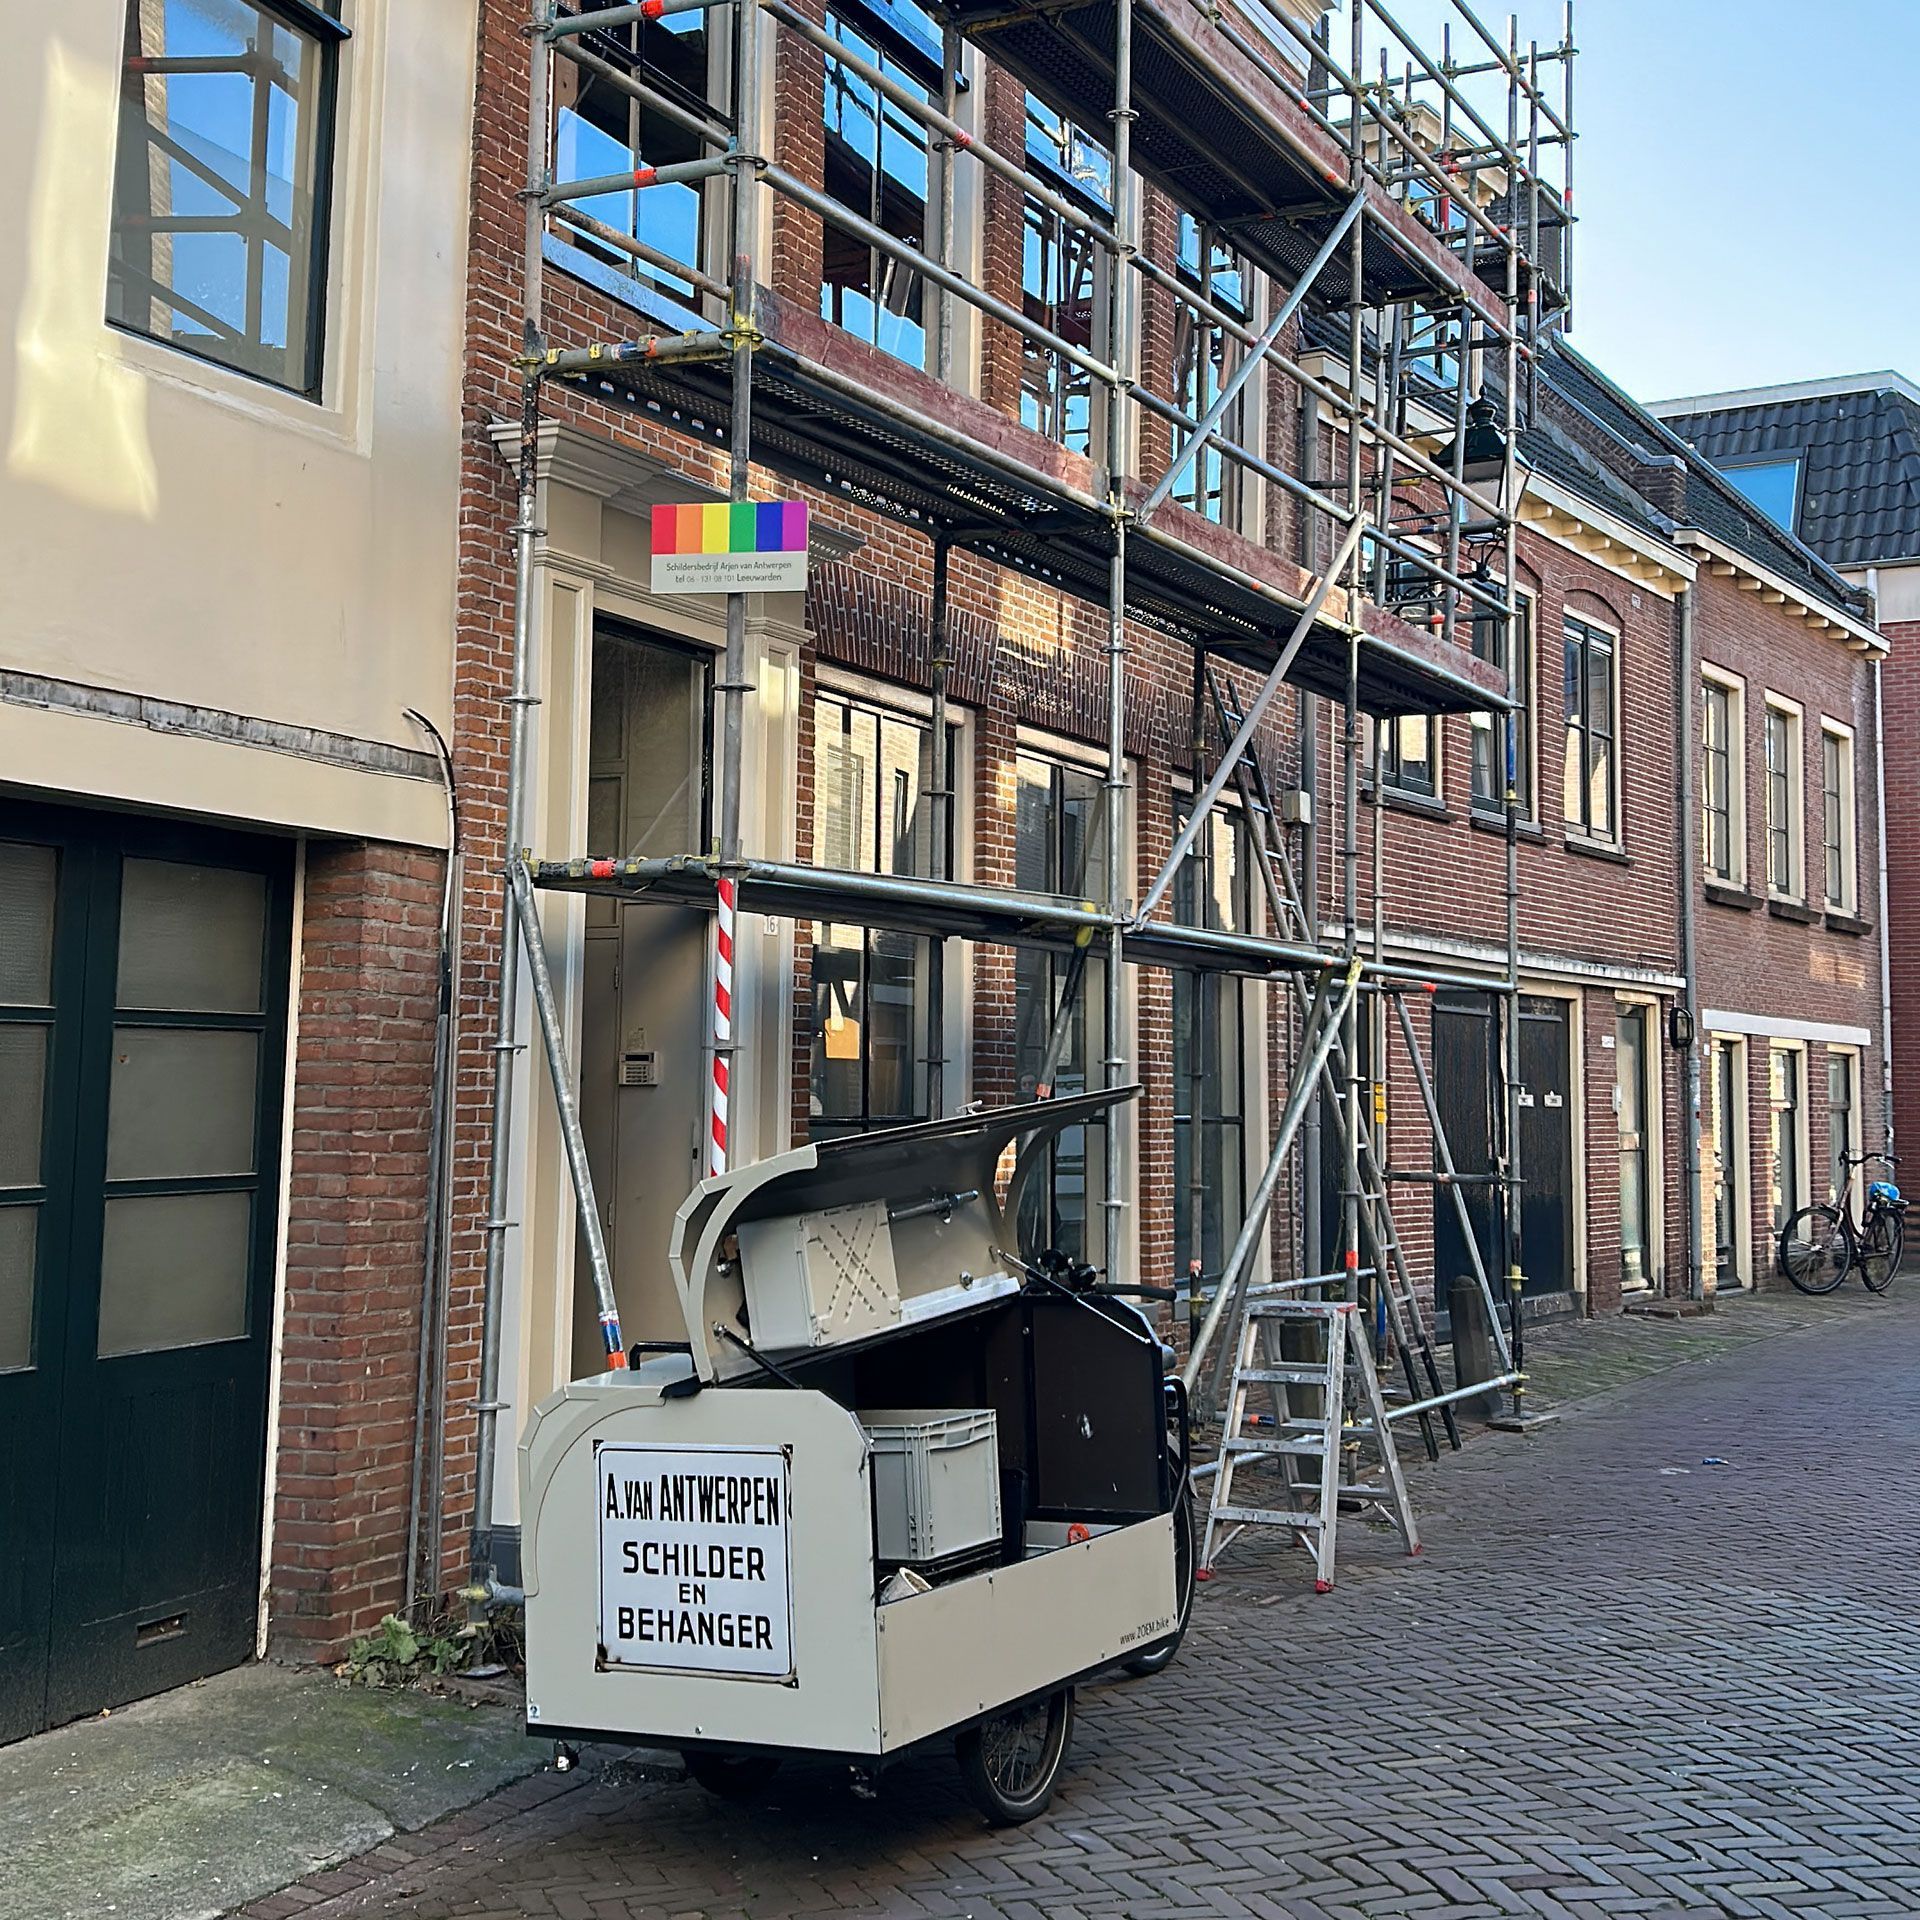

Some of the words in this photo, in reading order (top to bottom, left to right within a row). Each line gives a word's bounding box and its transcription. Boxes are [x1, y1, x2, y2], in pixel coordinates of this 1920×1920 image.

[666, 562, 718, 572] Schildersbedrijf
[720, 562, 738, 572] Arjen
[754, 562, 792, 570] Antwerpen
[736, 572, 782, 582] Leeuwarden
[766, 916, 776, 932] 16
[660, 1474, 780, 1526] ANTWERPEN
[622, 1541, 766, 1582] SCHILDER
[678, 1582, 706, 1605] EN
[618, 1606, 774, 1650] BEHANGER
